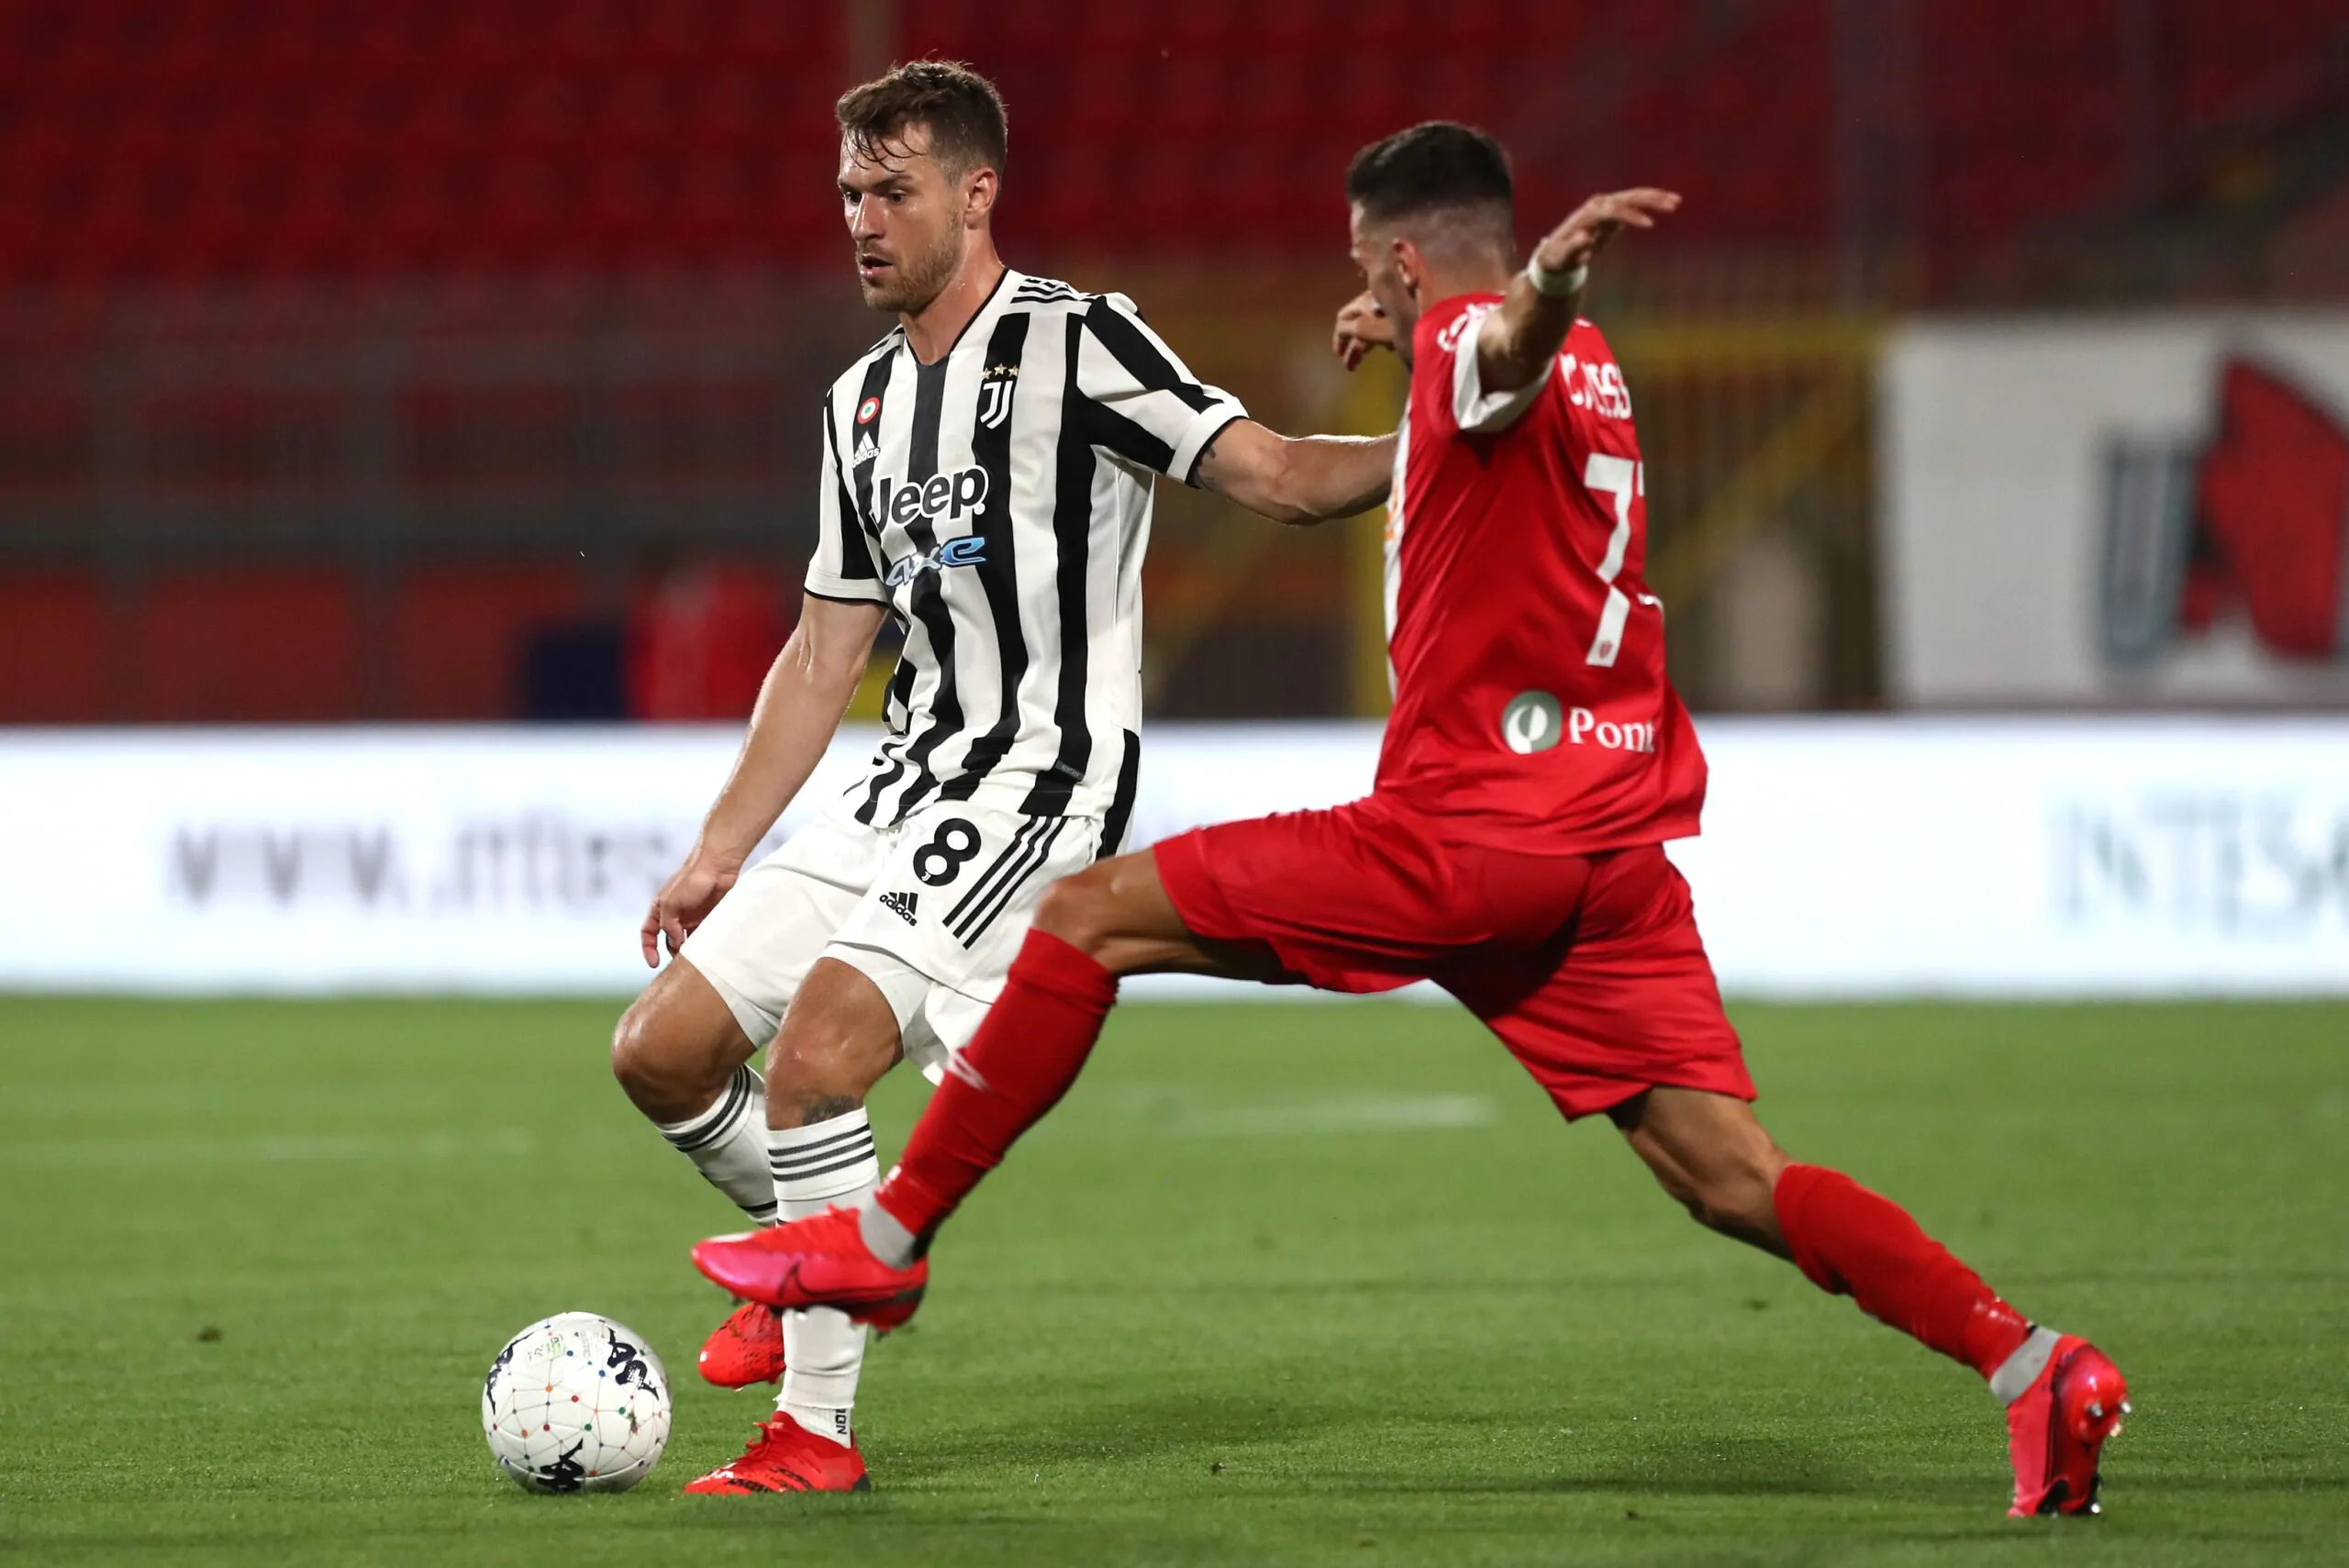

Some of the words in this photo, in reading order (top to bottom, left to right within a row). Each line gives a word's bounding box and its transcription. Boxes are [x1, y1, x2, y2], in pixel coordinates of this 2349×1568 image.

[870, 466, 988, 535] Jeep
[913, 817, 981, 887] 8
[879, 894, 918, 927] adidas
